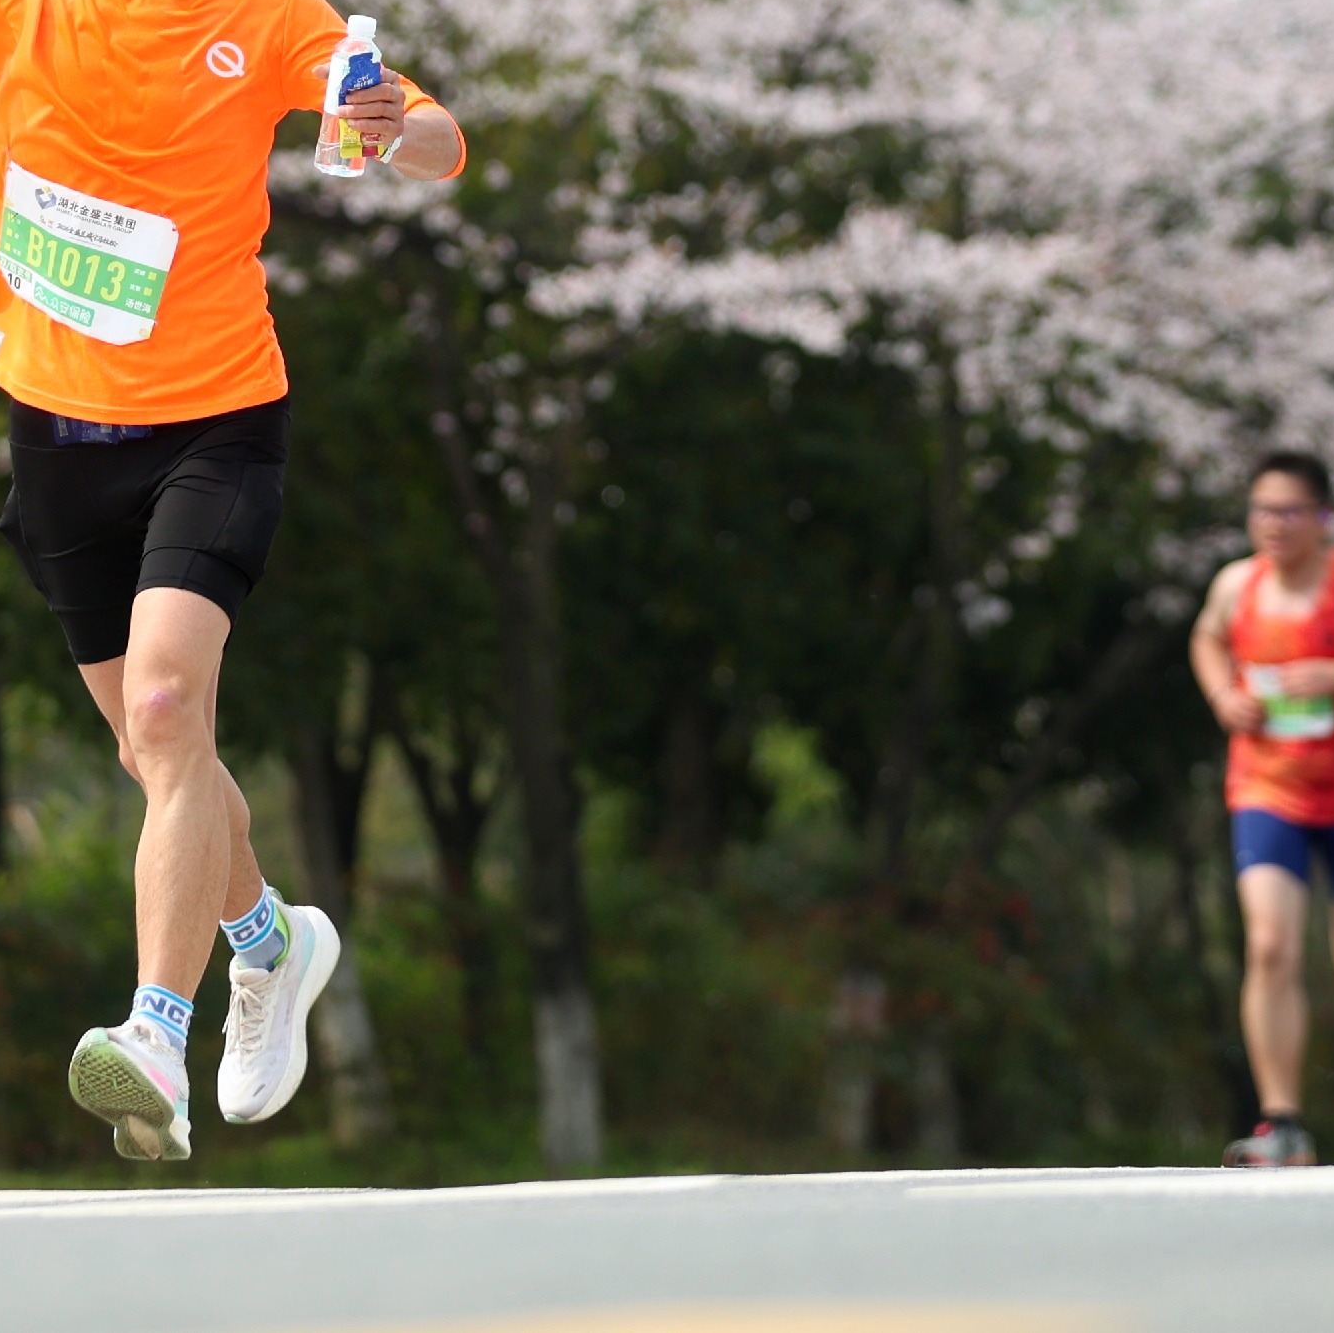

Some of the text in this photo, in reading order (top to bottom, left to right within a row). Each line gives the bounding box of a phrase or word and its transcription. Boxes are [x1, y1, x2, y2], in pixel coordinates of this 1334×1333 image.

[58, 197, 137, 230] 湖北金盛兰集团
[112, 225, 133, 235] GROUP
[26, 226, 126, 302] B1013
[7, 273, 21, 289] 10
[50, 296, 91, 325] 众安保险
[125, 298, 152, 314] 汤世海
